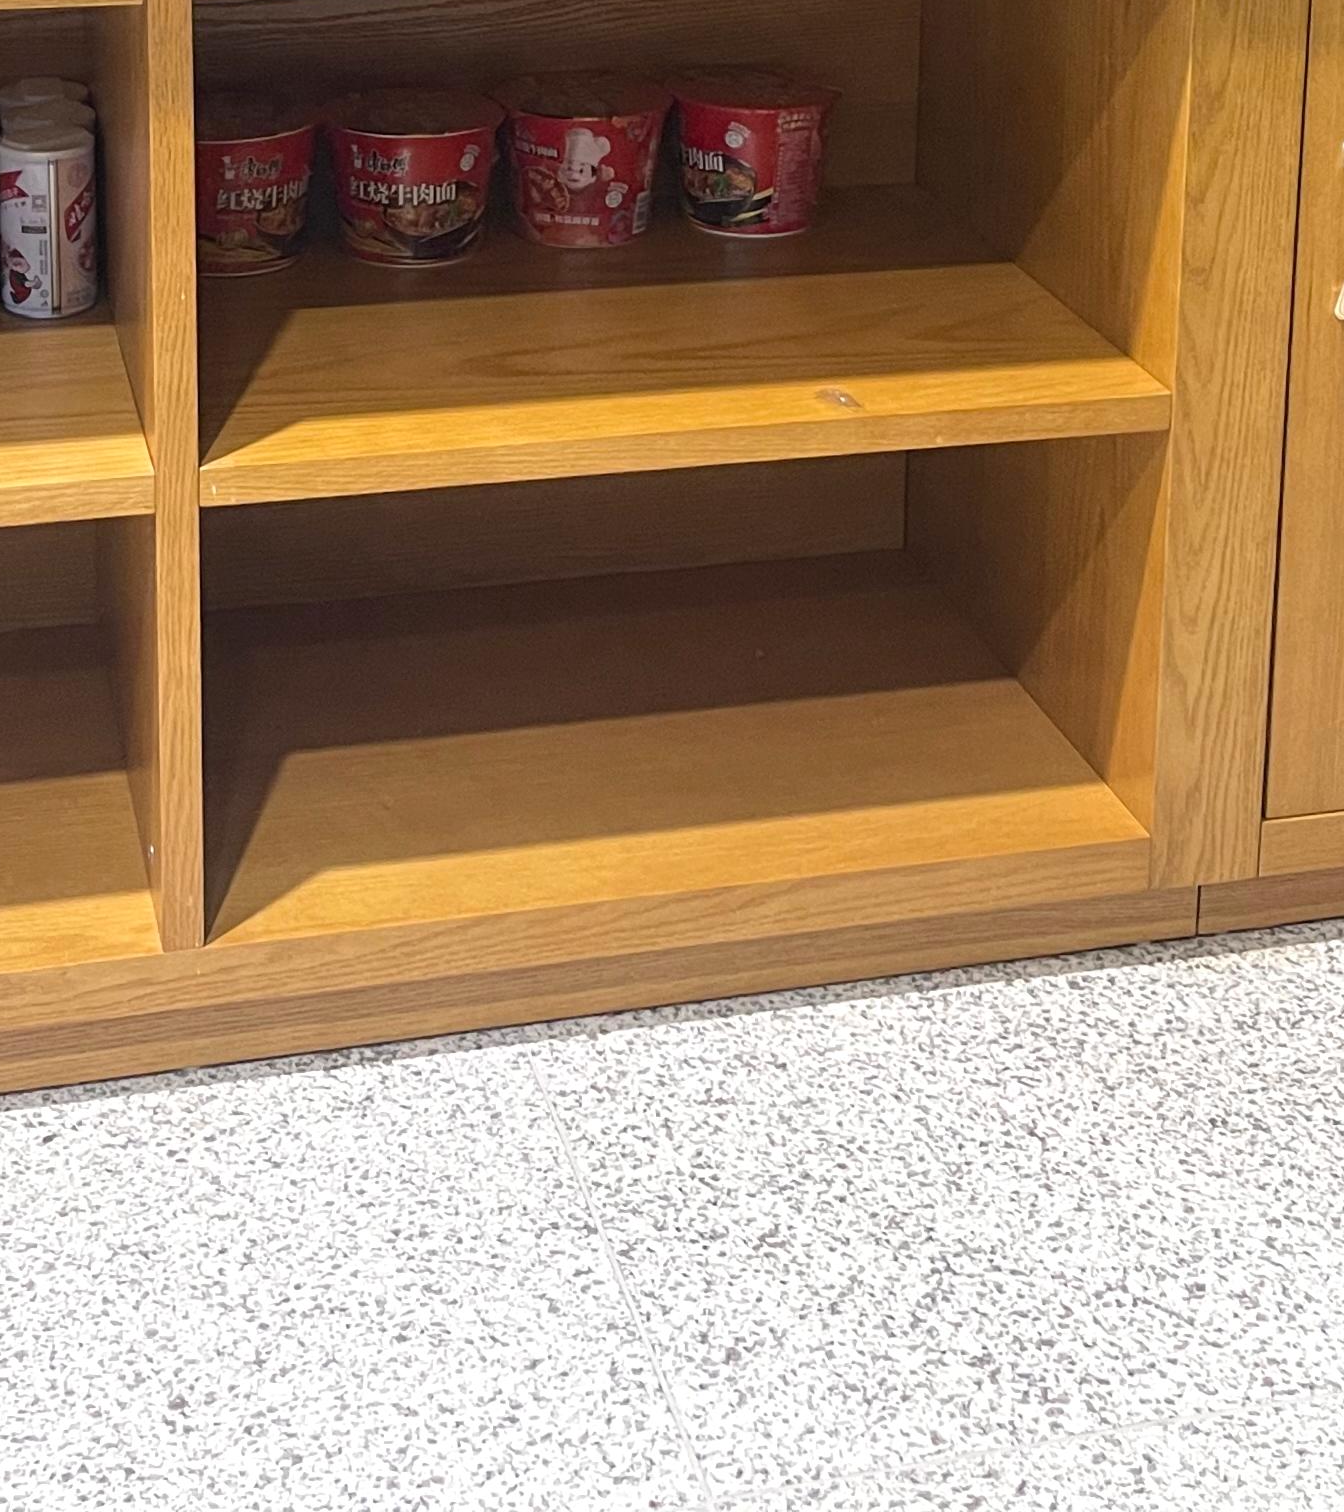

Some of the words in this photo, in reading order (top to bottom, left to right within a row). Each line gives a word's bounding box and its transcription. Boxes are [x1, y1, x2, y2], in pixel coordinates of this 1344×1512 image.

[350, 175, 457, 206] 红烧牛肉面
